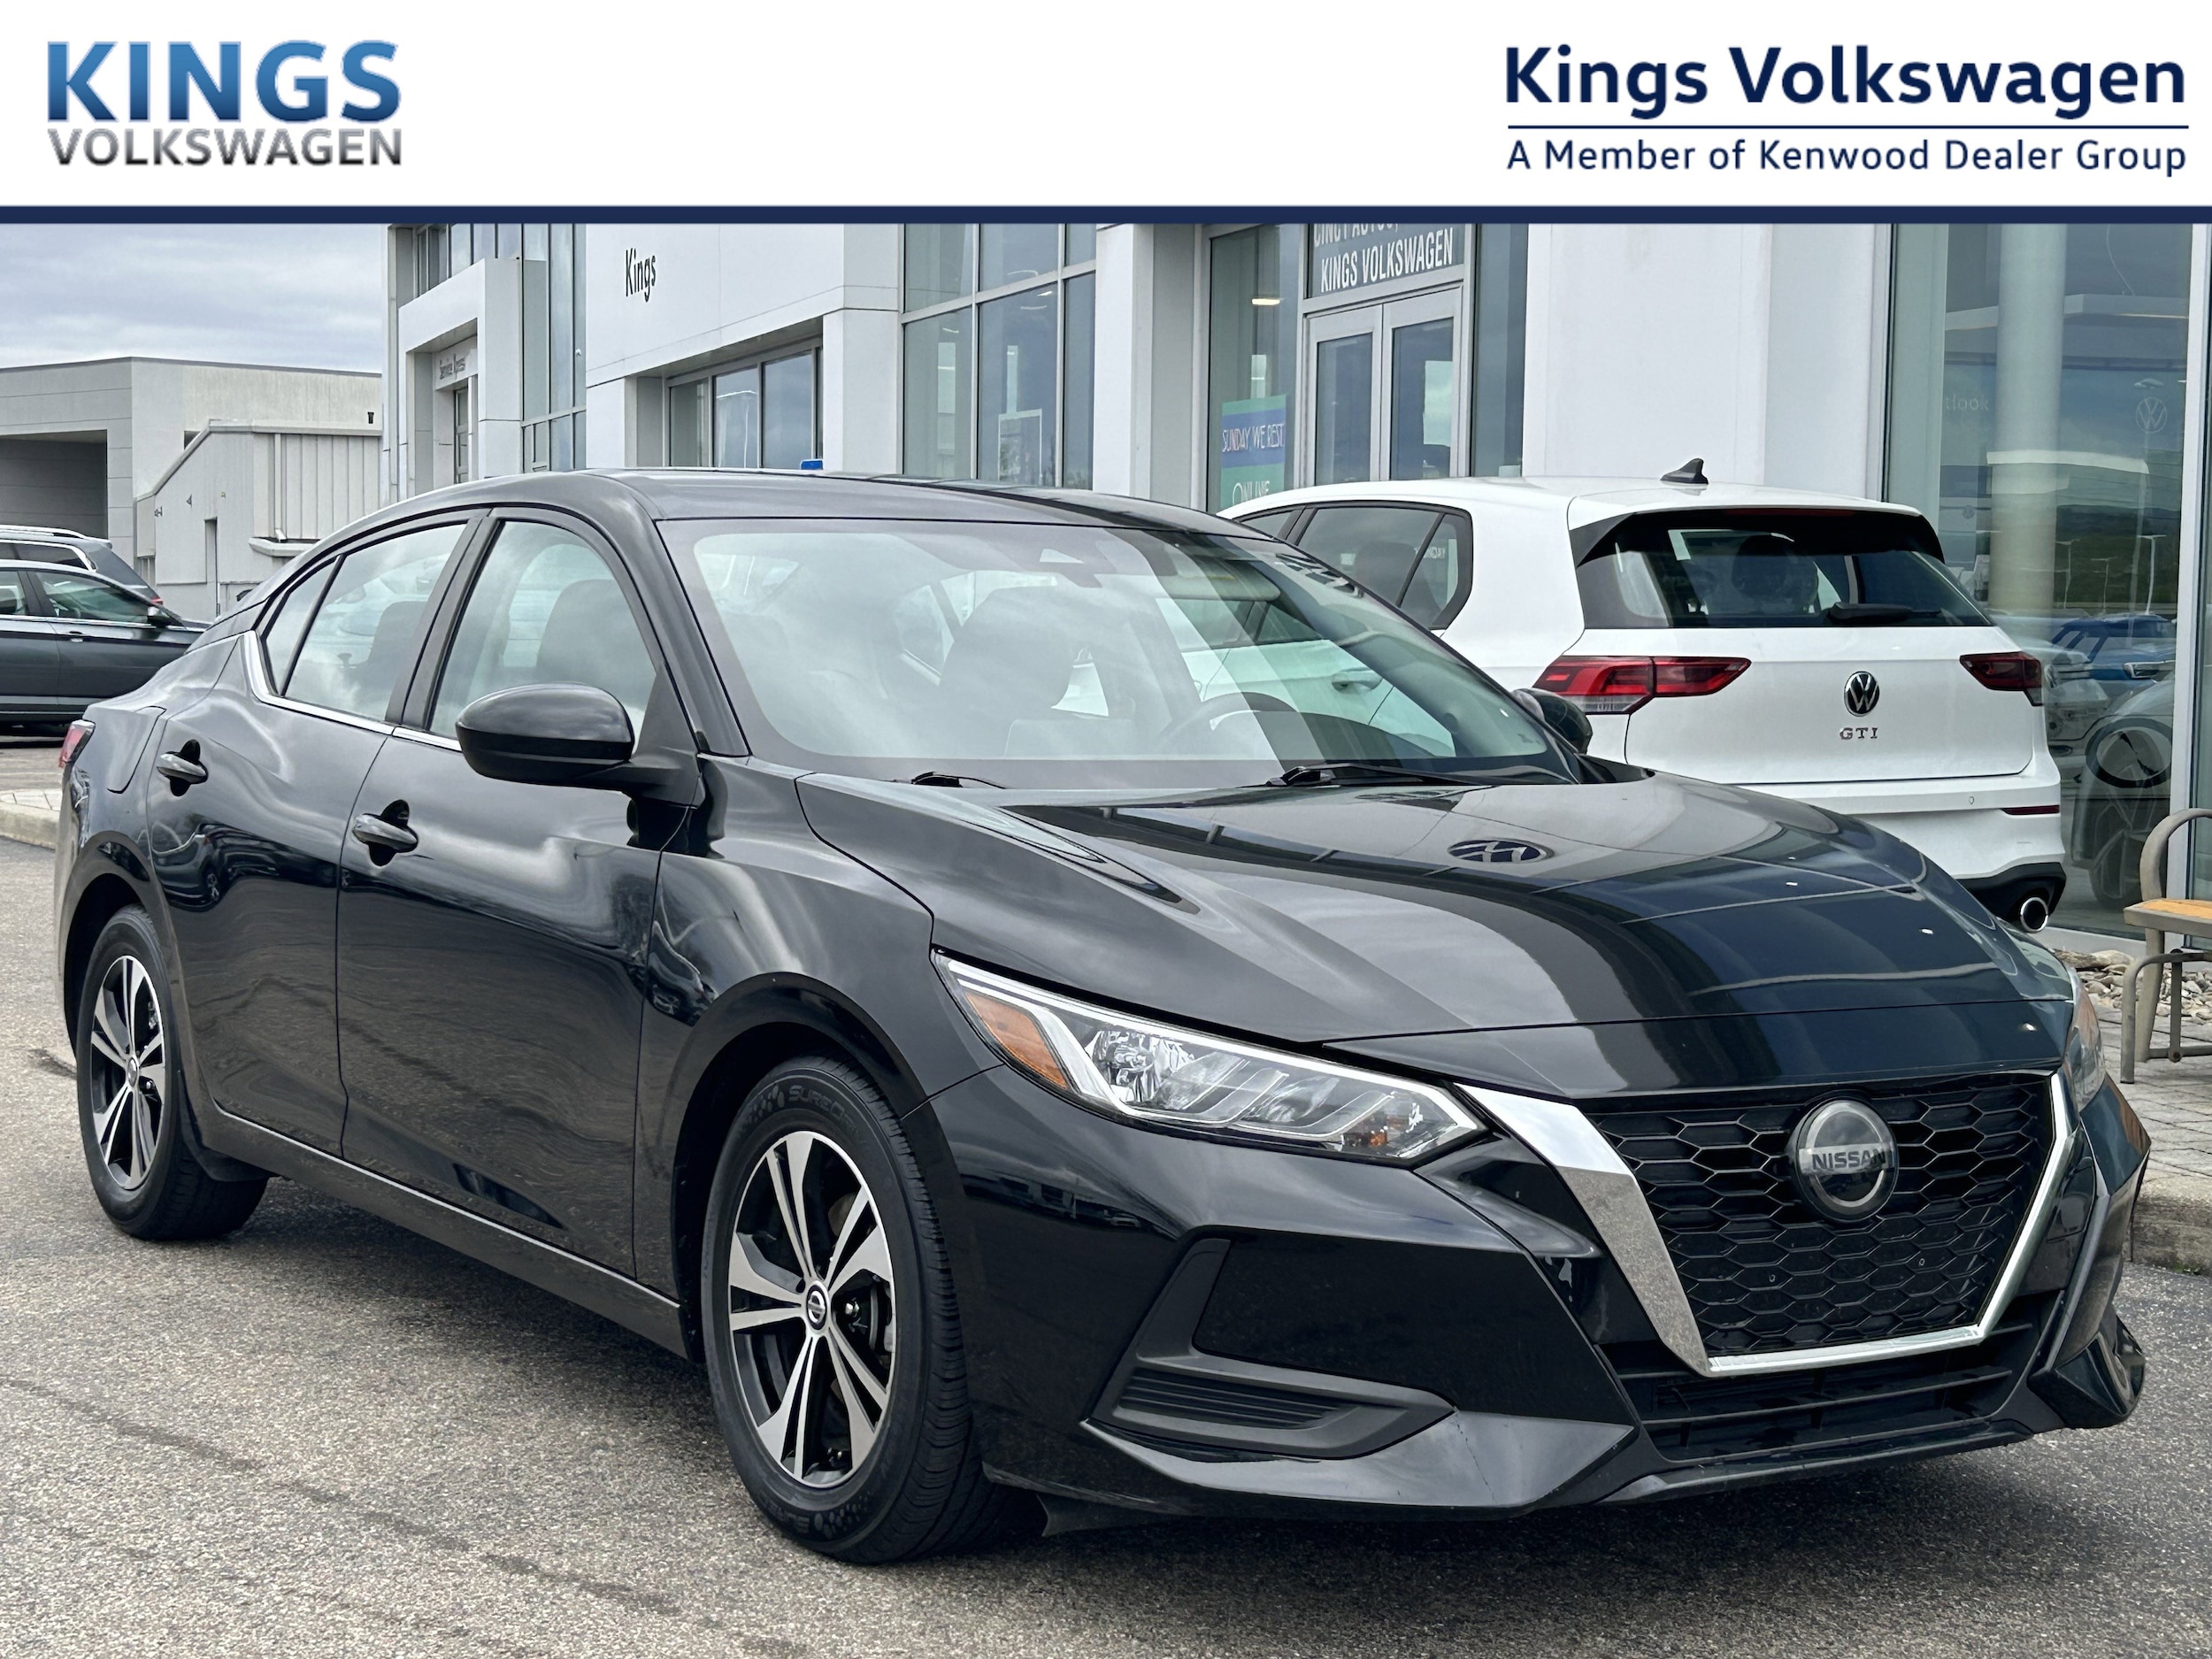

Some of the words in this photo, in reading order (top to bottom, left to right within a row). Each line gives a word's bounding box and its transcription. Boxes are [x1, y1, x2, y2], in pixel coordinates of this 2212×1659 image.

[626, 247, 656, 303] Kings
[1321, 250, 1358, 293] KINGS
[1362, 227, 1454, 283] VOLKSWAGEN
[1839, 727, 1878, 740] GTI
[1812, 1148, 1887, 1170] NISSAN
